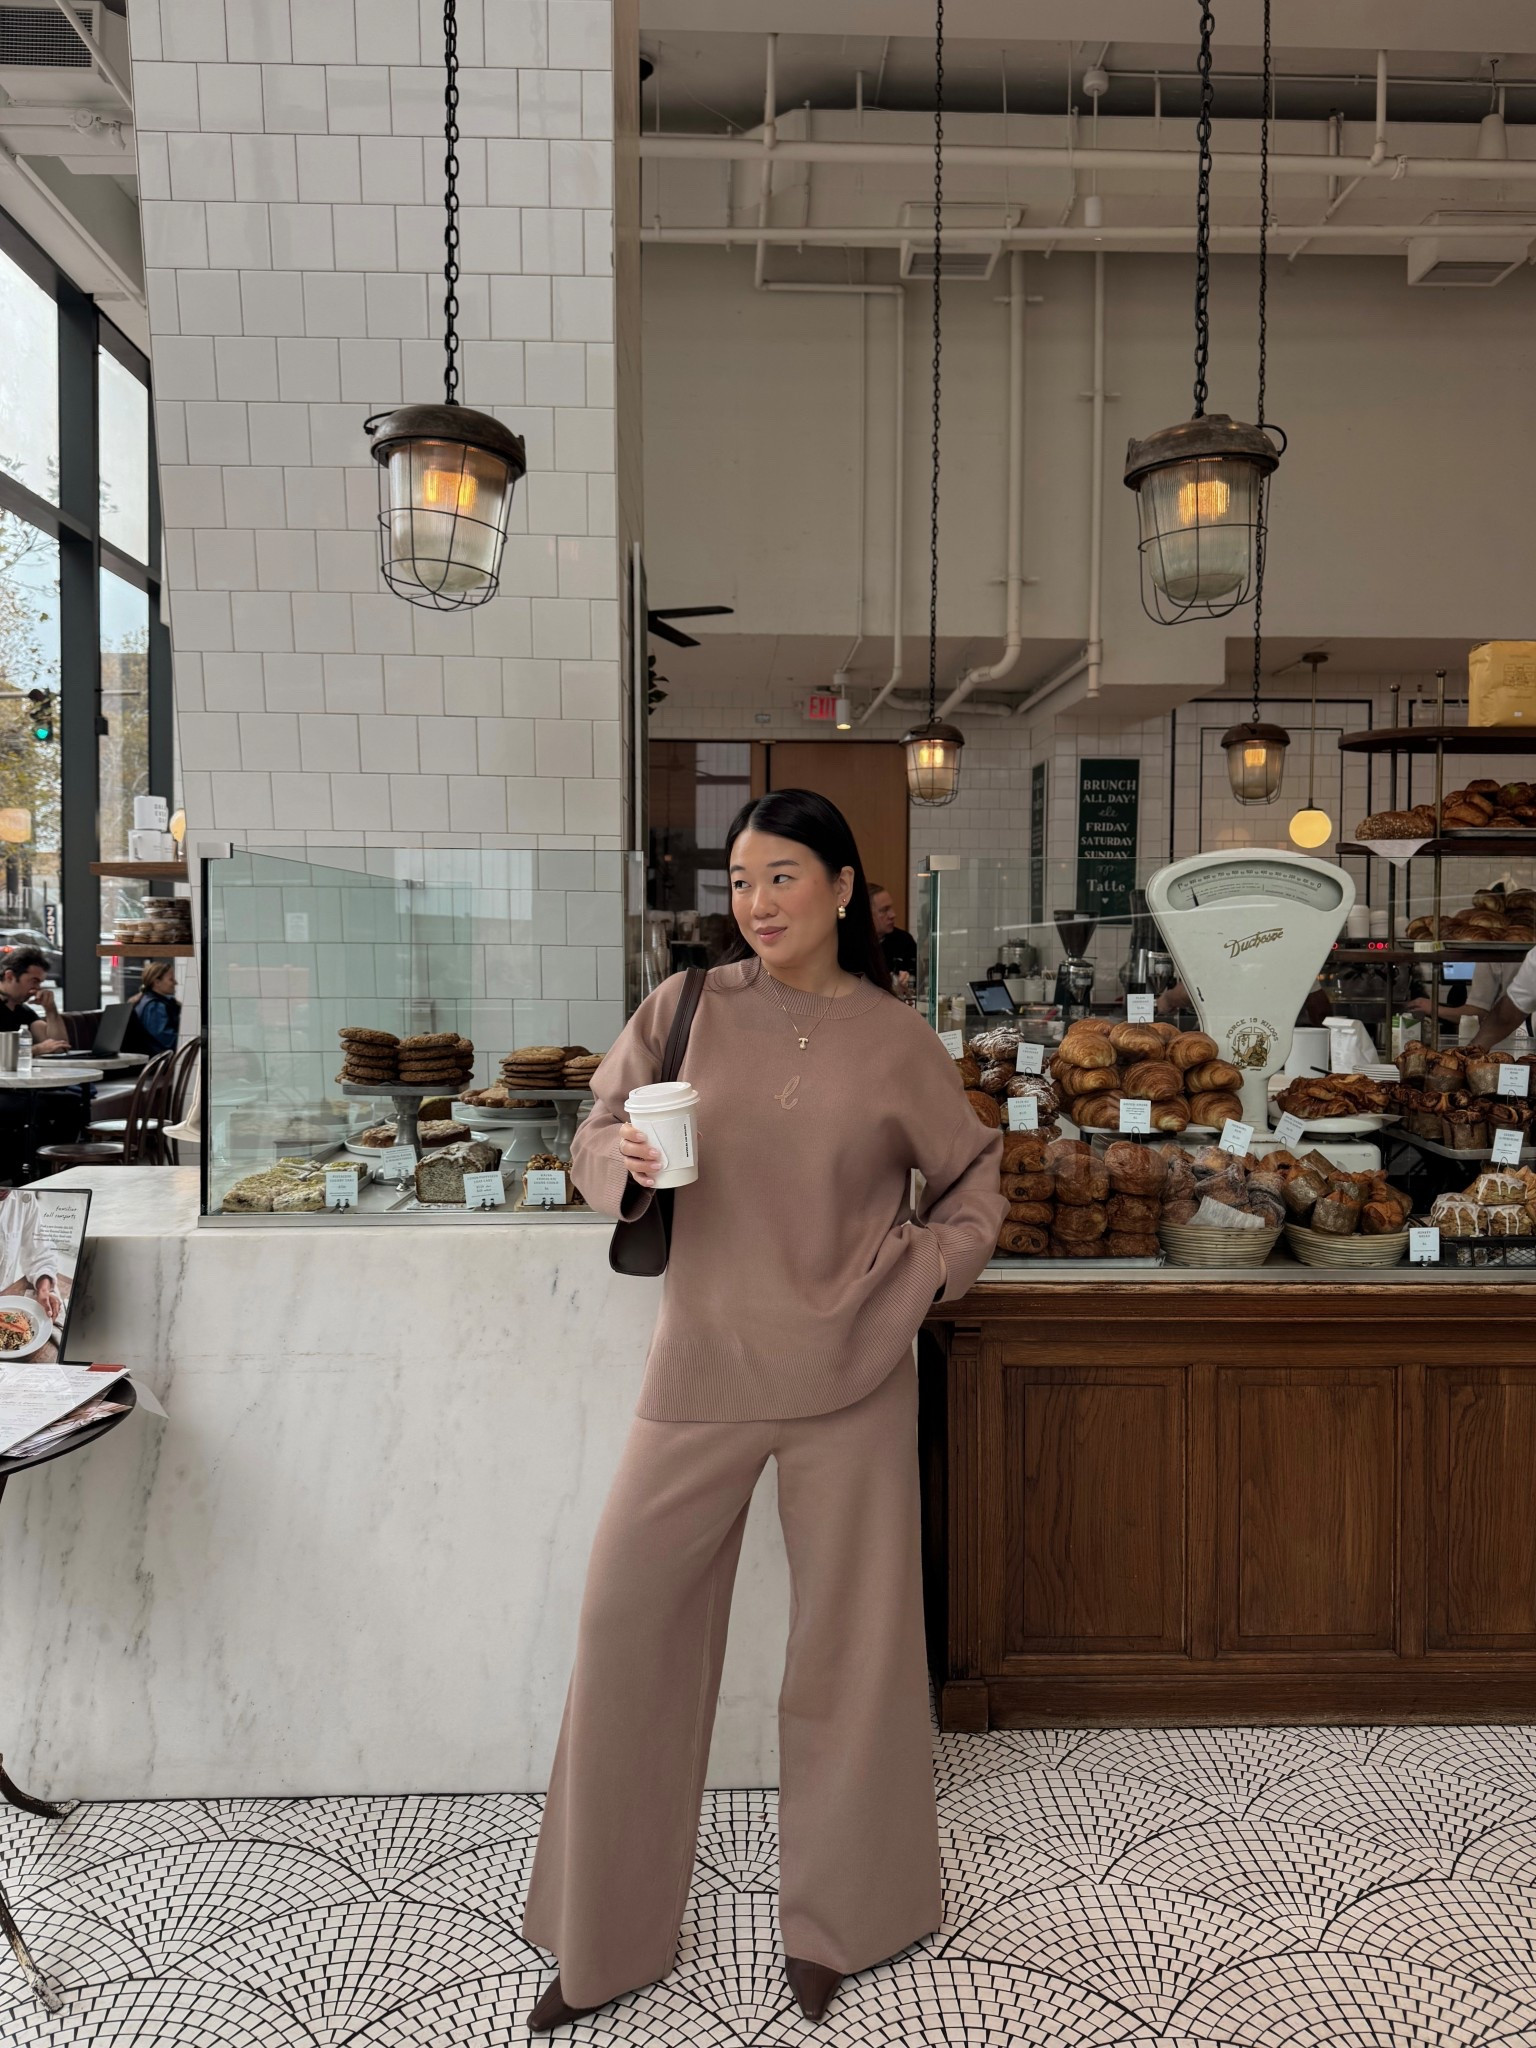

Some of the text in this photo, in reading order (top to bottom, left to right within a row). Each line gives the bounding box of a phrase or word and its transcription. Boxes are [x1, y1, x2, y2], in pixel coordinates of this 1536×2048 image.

[809, 695, 837, 719] EXIT
[1083, 779, 1136, 791] BRUNCH
[1083, 794, 1135, 803] ALL DAY!
[1085, 822, 1130, 832] FRIDAY
[1081, 837, 1135, 846] SATURDAY
[1084, 850, 1130, 860] SUNDAY
[1086, 879, 1126, 892] Tatte
[1225, 1018, 1246, 1039] FORCE
[1260, 1019, 1279, 1041] KILOGS
